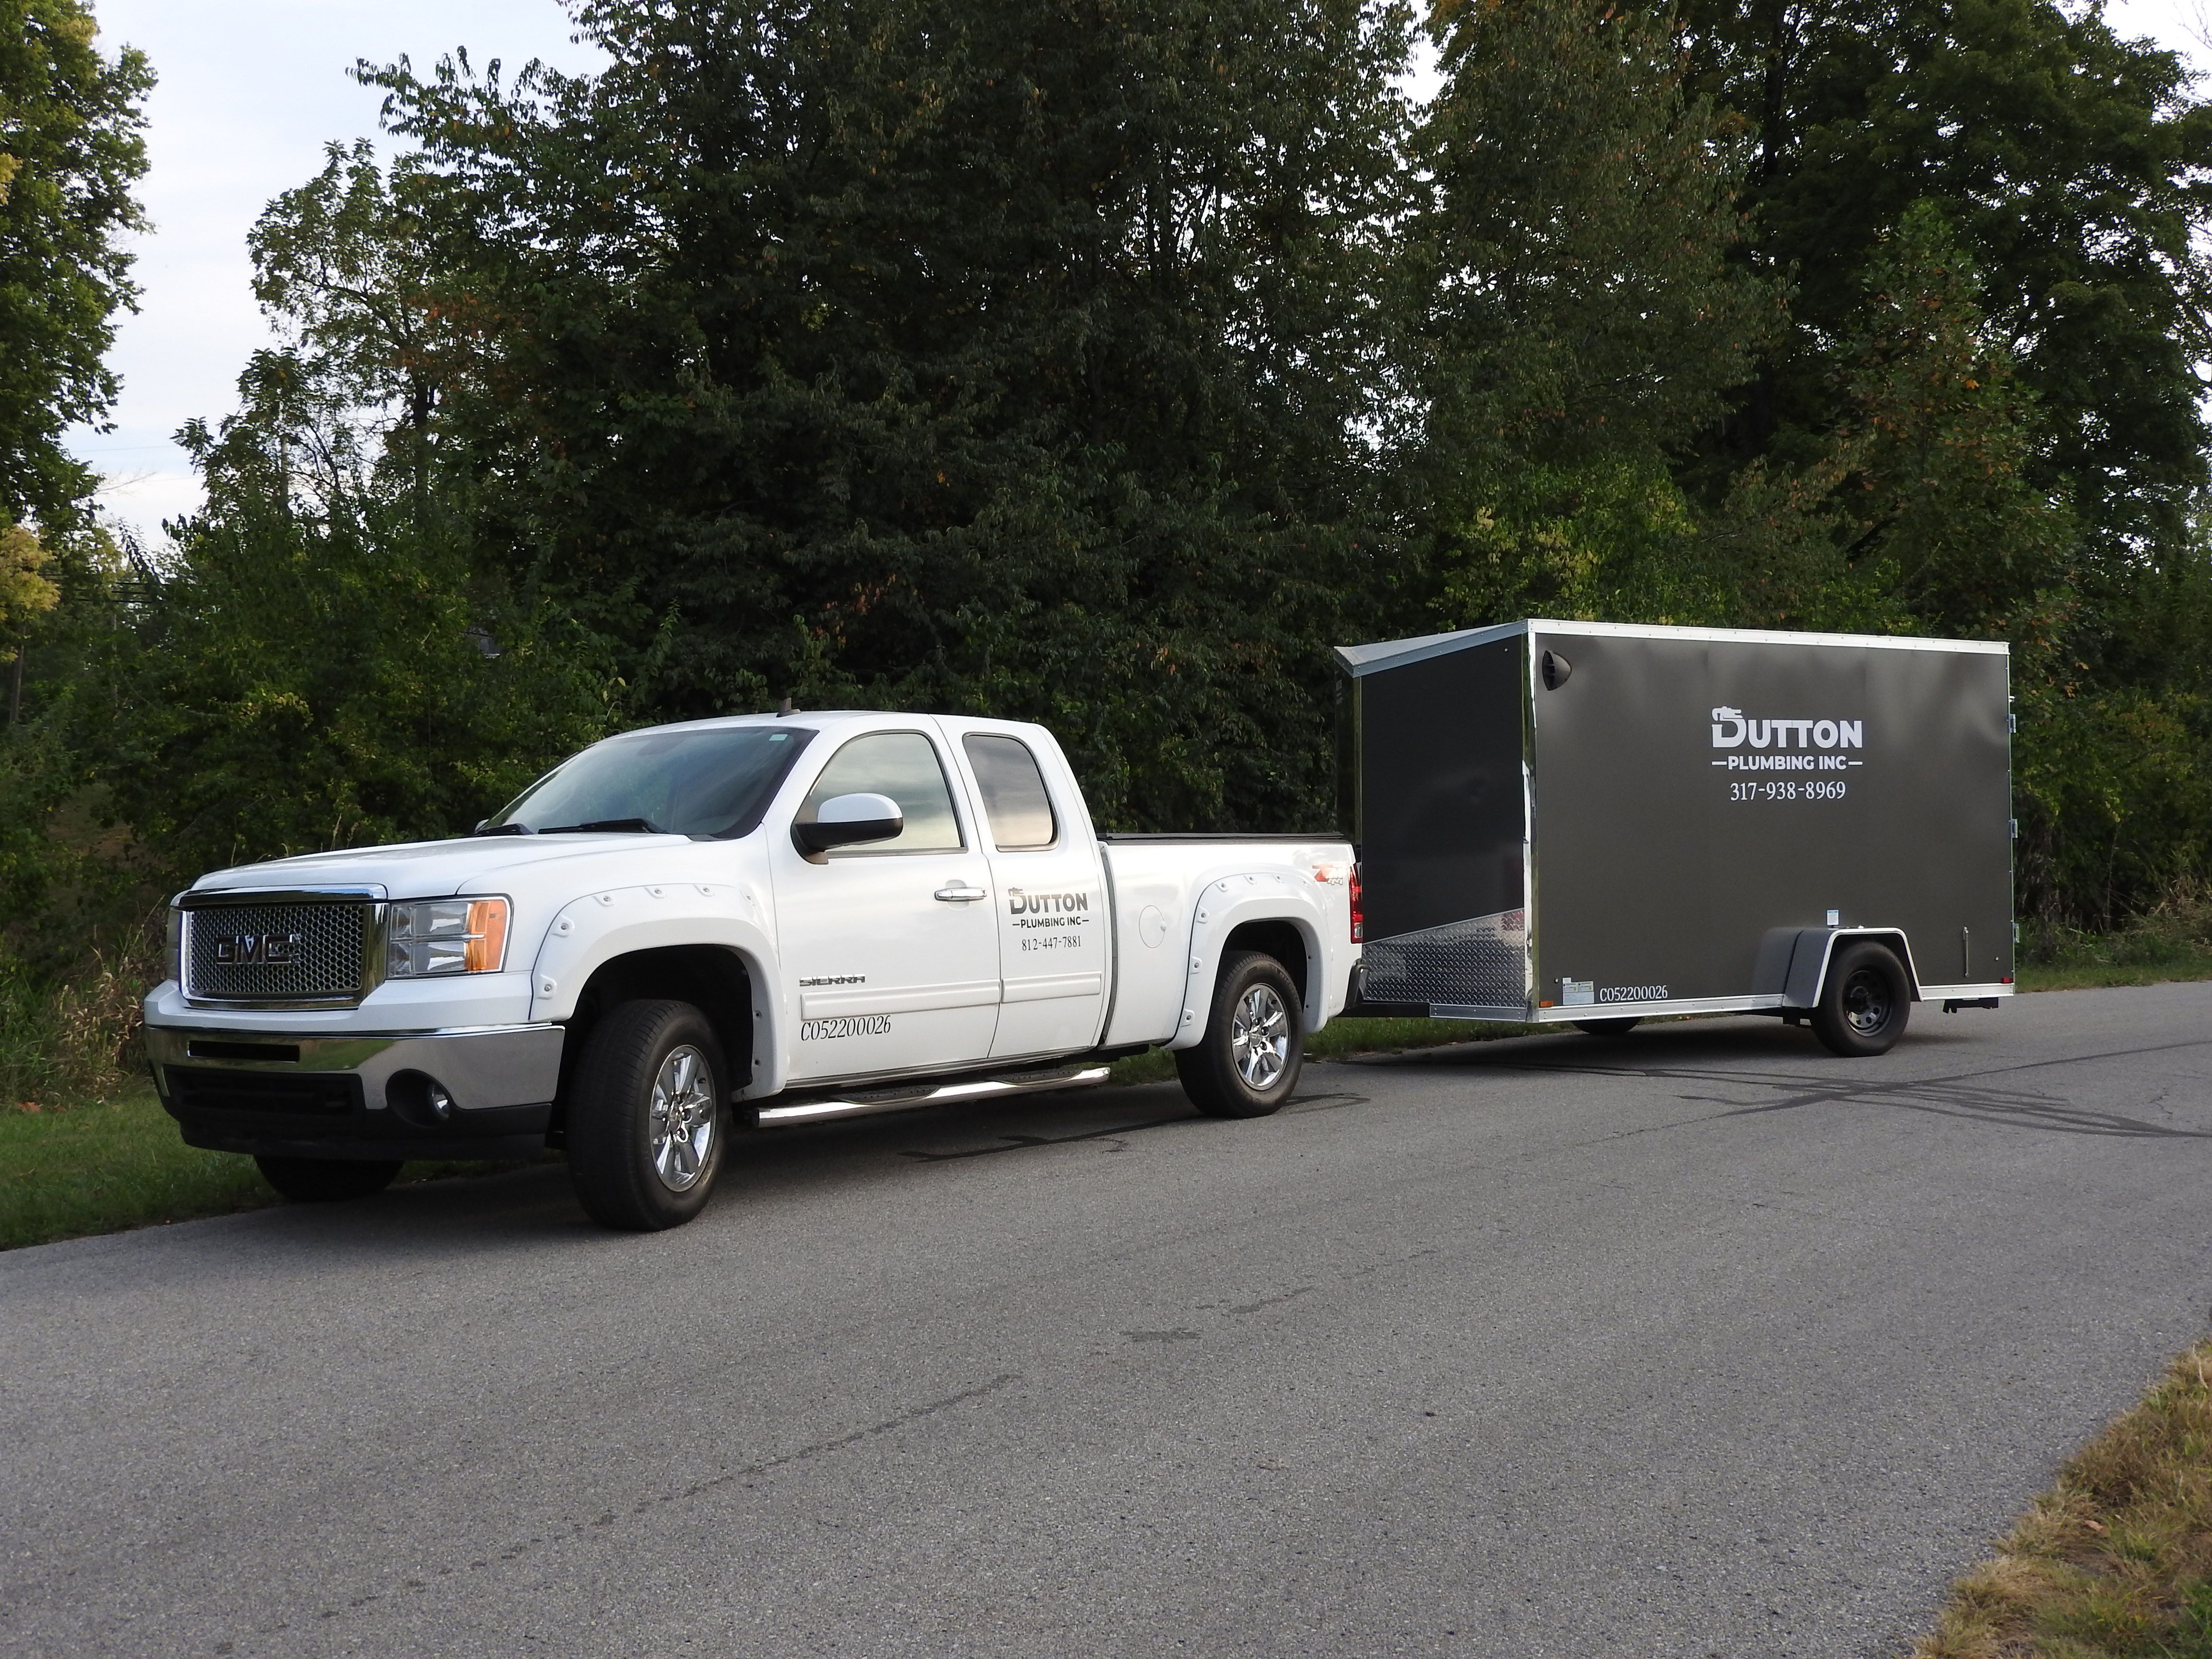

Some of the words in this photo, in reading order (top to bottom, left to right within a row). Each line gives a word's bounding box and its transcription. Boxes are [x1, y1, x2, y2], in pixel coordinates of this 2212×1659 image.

[1711, 706, 1863, 748] DUTTON
[1728, 756, 1815, 770] PLUMBING
[1818, 756, 1847, 769] INC
[1730, 781, 1846, 801] 317-938-8969
[1008, 887, 1088, 914] DUTTON
[1021, 917, 1065, 928] PLUMBING
[1067, 916, 1082, 926] INC
[216, 935, 294, 965] GMC
[1022, 935, 1081, 951] 812-447-7881
[799, 974, 866, 987] SIERRA
